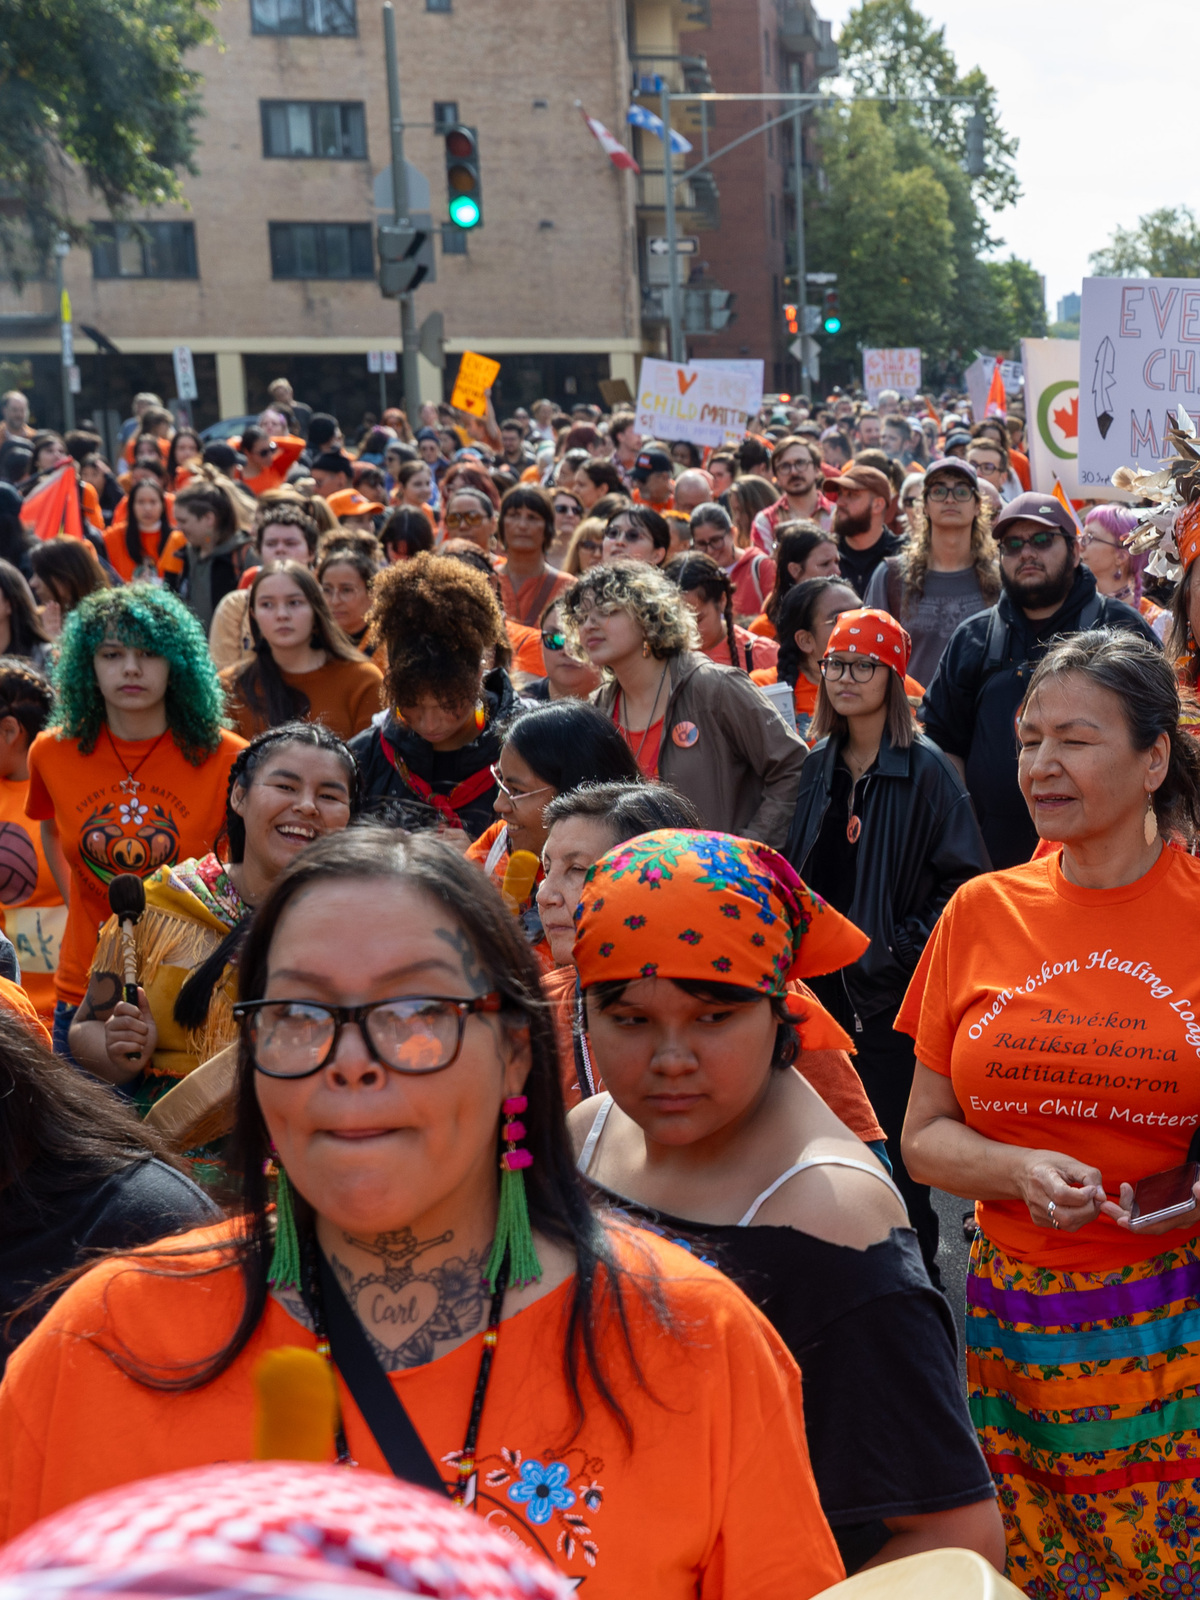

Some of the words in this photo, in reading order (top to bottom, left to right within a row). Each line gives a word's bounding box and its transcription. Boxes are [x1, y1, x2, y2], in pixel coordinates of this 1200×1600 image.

[641, 392, 698, 420] CHILD
[1082, 470, 1095, 483] 30
[75, 788, 106, 813] EVERY
[151, 786, 190, 819] MATTERS
[1085, 949, 1173, 1000] Healing
[1031, 1008, 1148, 1031] Akwé:kon
[970, 1096, 1028, 1116] Every
[1038, 1099, 1098, 1119] Child
[1109, 1106, 1199, 1127] Matters
[371, 1294, 420, 1325] Carl
